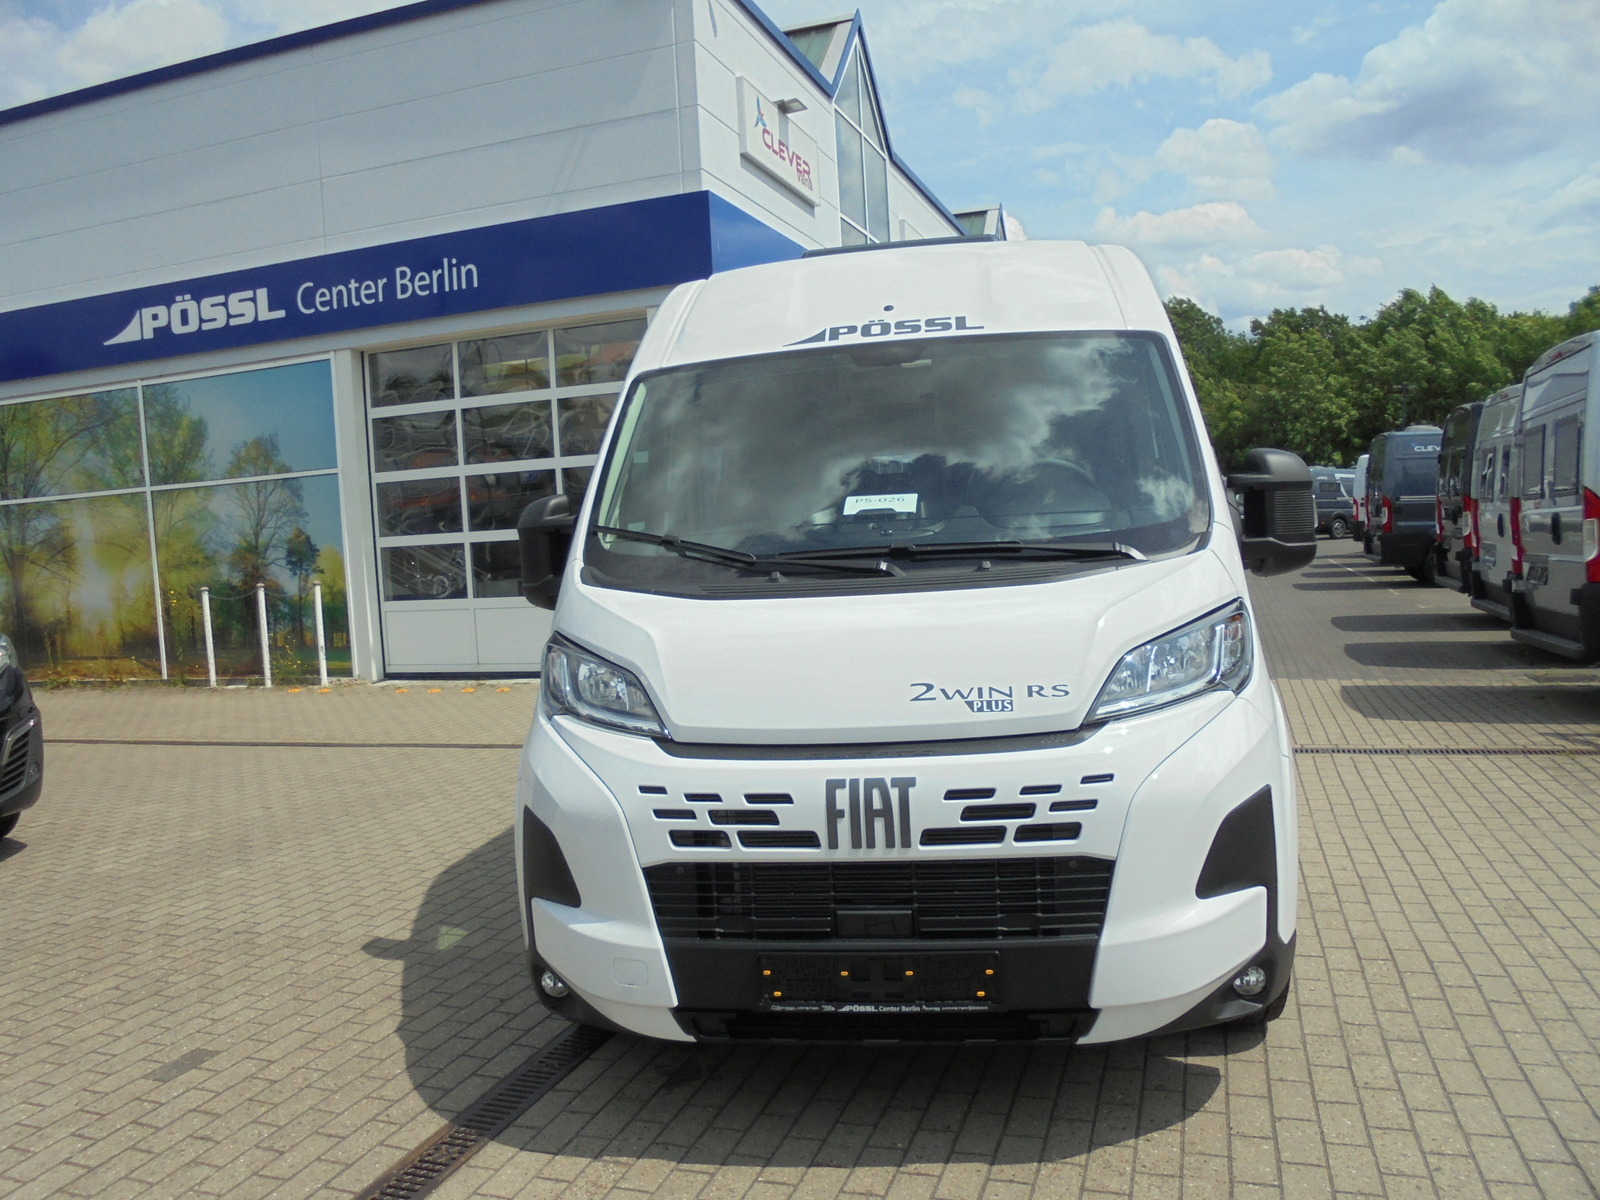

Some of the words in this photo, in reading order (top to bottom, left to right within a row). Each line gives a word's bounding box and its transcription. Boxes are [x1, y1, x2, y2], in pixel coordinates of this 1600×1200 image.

[762, 127, 811, 178] CLEVER
[142, 288, 286, 339] PÖSSL
[297, 277, 387, 314] Center
[395, 258, 478, 300] Berlin
[828, 316, 984, 341] PÖSSL
[910, 683, 1013, 701] 2WIN
[1027, 684, 1070, 698] RS
[973, 700, 1012, 712] PLUS
[826, 777, 916, 849] FIAT
[846, 1004, 878, 1012] PÖSSL
